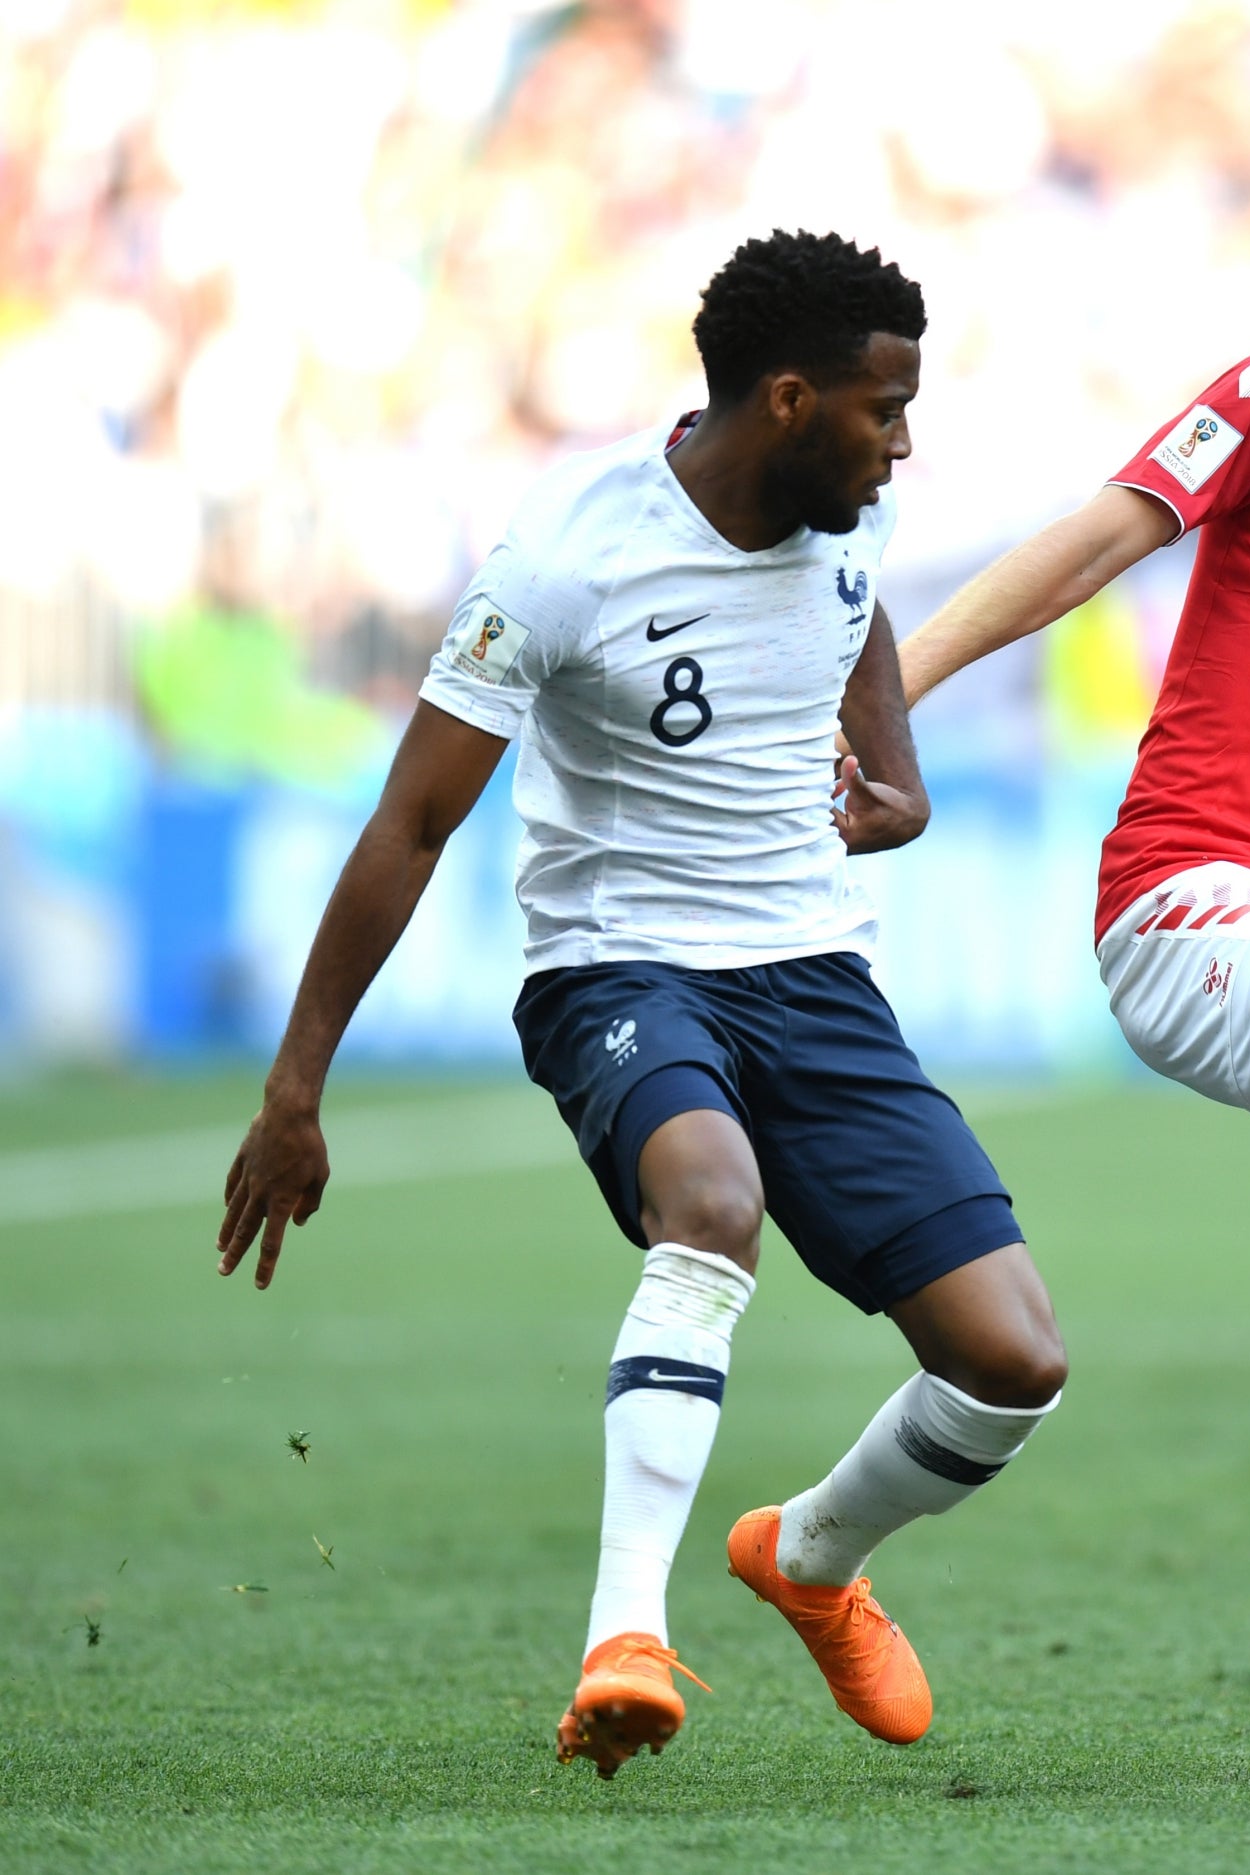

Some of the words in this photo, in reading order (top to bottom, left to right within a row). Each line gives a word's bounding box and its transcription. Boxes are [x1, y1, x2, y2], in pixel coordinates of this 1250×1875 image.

[1177, 468, 1196, 486] 2018
[650, 657, 712, 747] 8
[1219, 962, 1234, 1008] hummel
